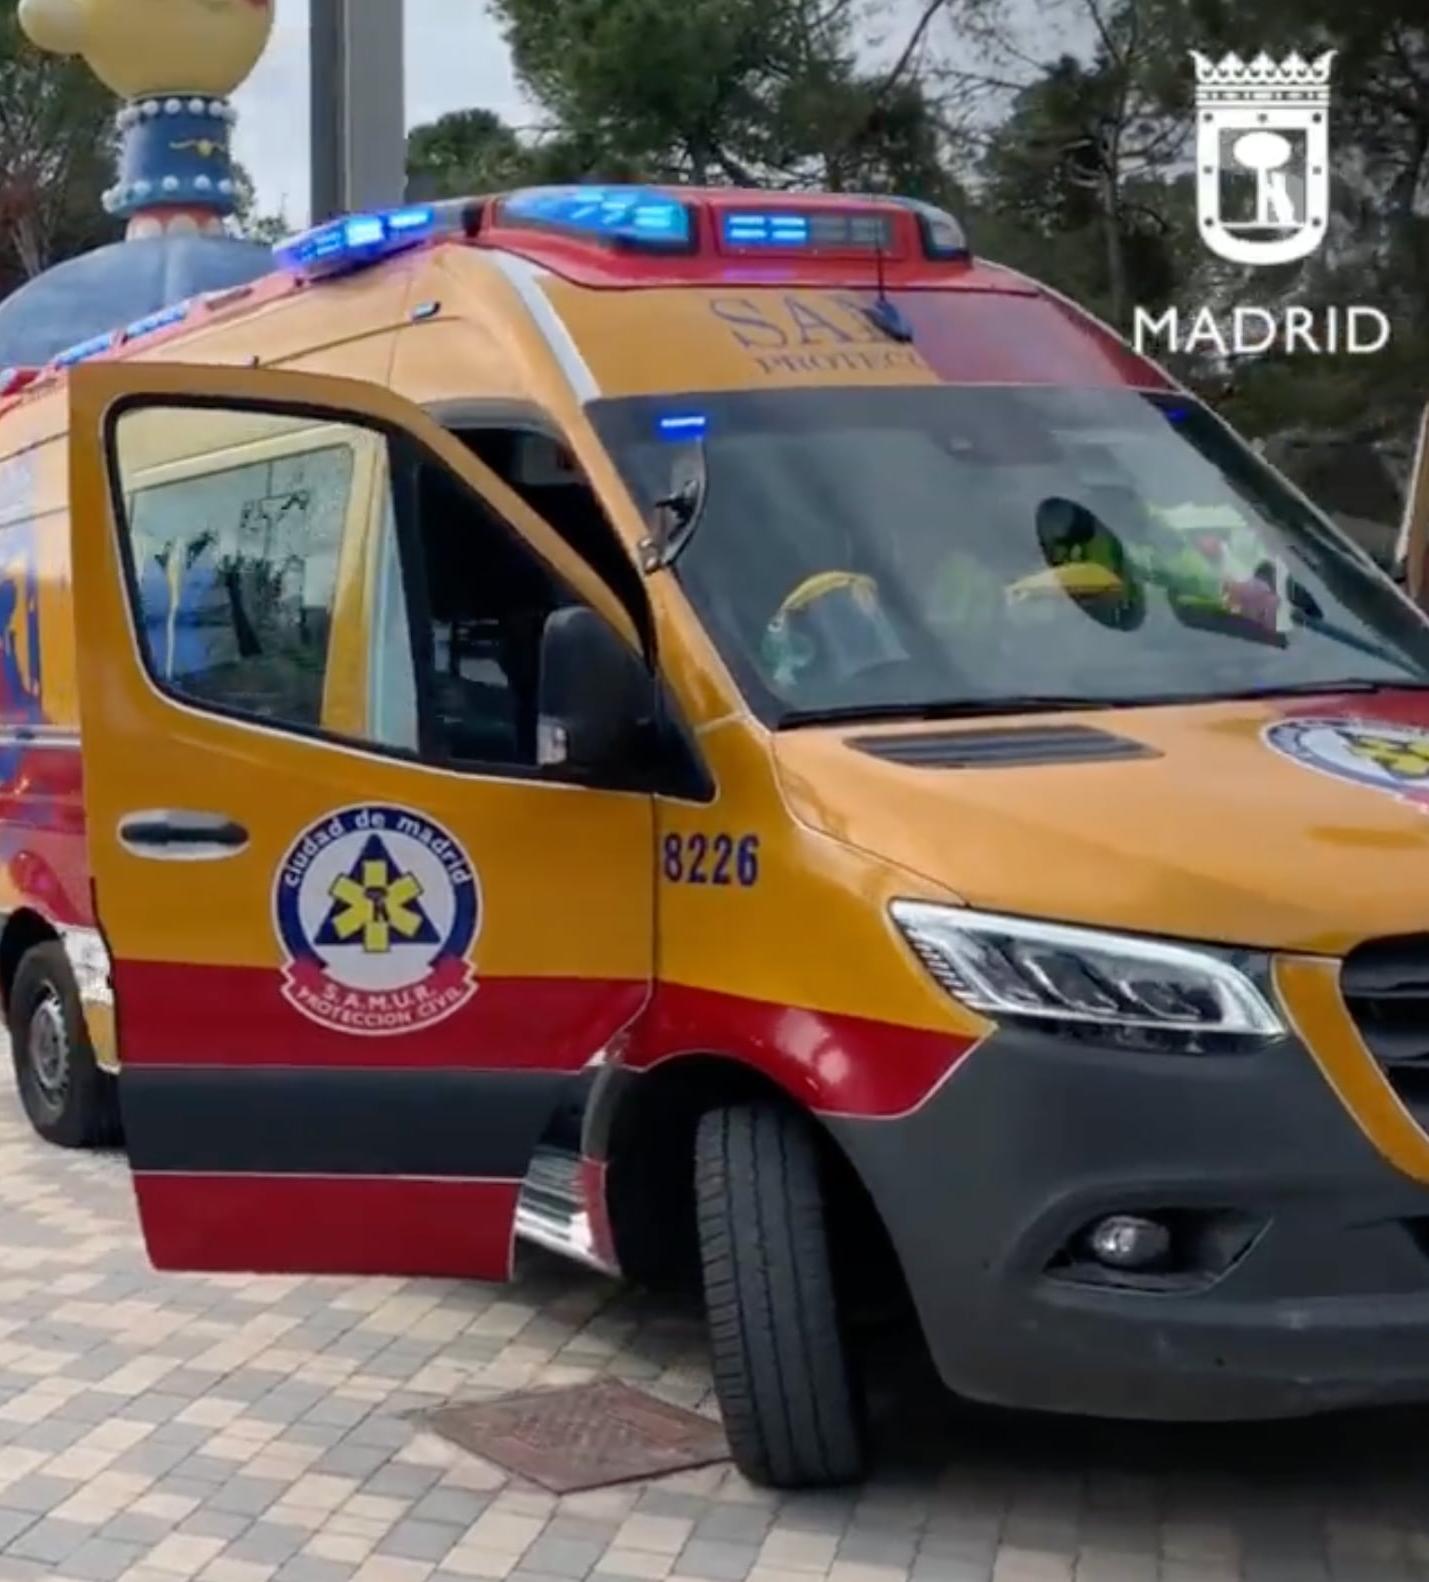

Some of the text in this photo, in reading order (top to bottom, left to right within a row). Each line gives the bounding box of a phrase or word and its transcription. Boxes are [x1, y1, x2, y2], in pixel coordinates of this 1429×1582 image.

[285, 809, 473, 888] ciudad de madrid
[663, 832, 760, 888] 8226
[323, 984, 438, 1011] S.A.M.U.R.
[417, 986, 463, 1018] CIVIL
